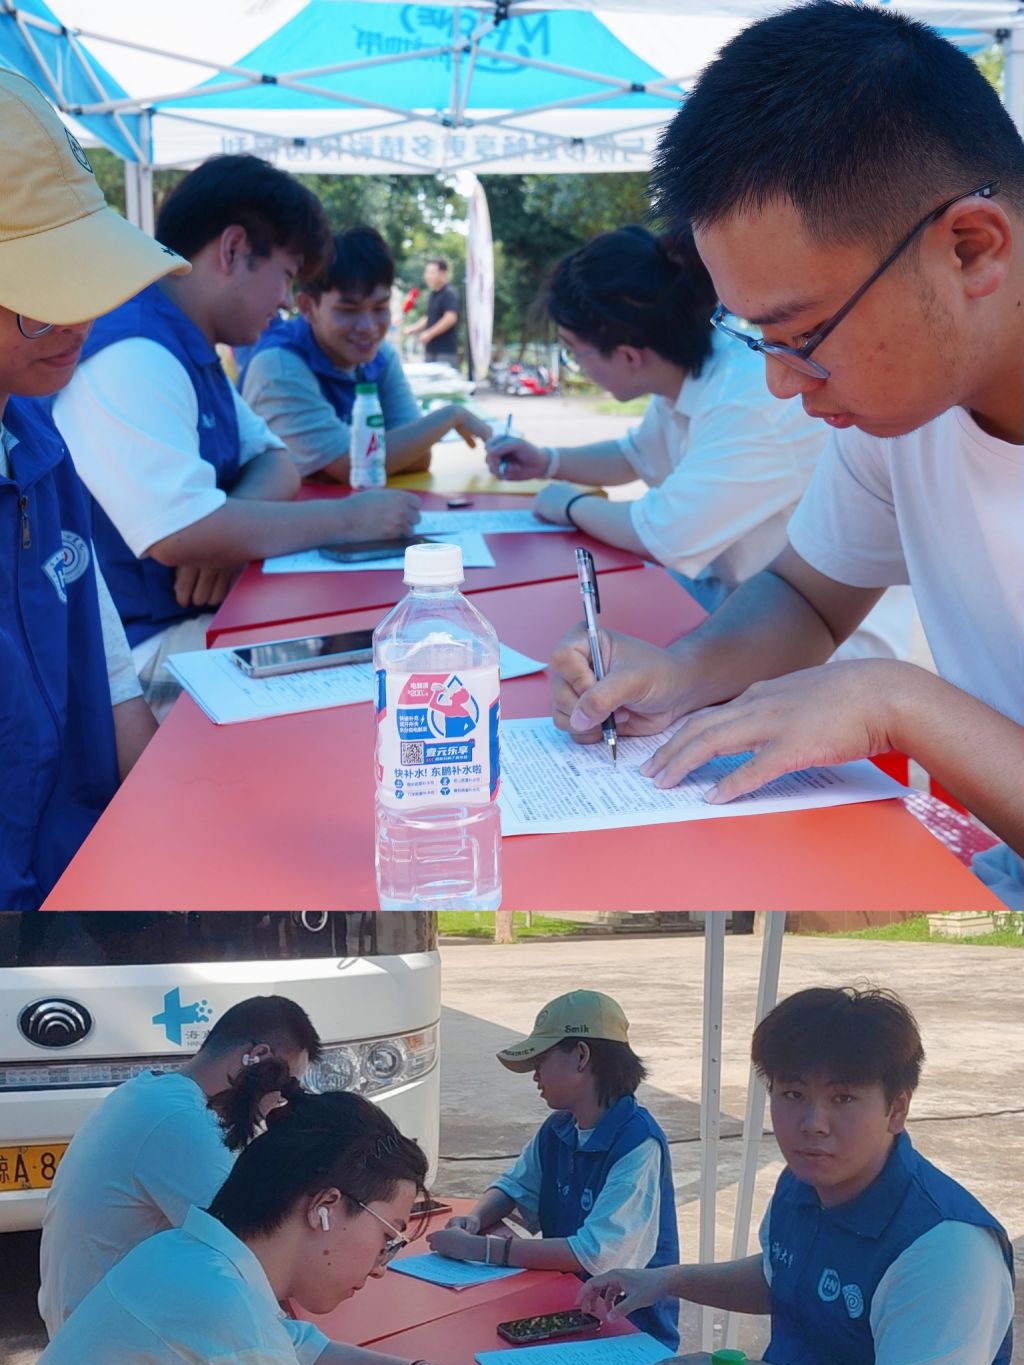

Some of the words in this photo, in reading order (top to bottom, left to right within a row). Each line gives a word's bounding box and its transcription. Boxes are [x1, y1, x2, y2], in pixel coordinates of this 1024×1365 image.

[431, 764, 482, 777] 东鹏补水啦
